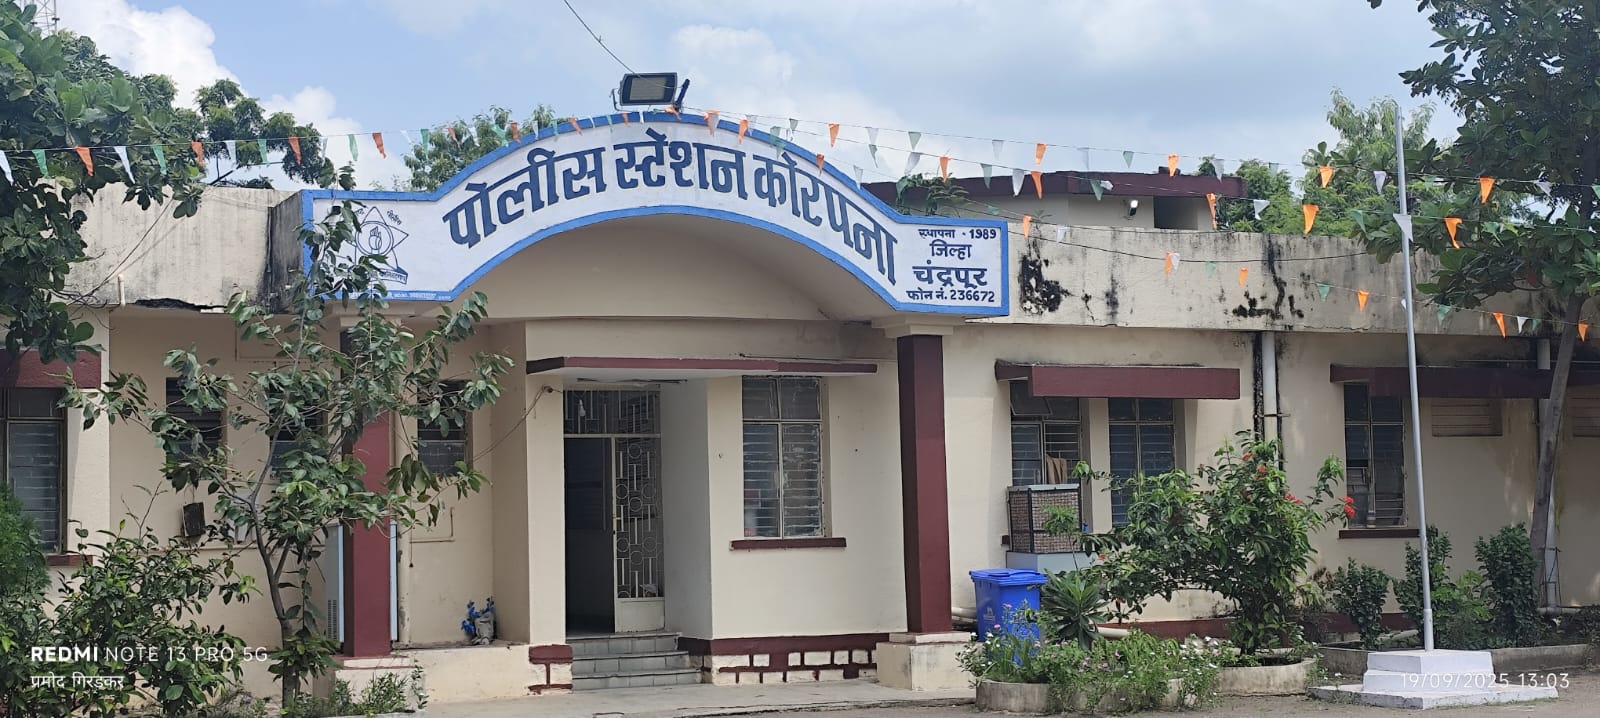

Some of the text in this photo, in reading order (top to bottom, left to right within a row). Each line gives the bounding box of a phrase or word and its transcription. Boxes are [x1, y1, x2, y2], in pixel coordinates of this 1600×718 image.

[442, 128, 899, 286] पोलीस स्टेशन कोरपना
[918, 228, 956, 239] स्थापना
[969, 228, 997, 240] 1989
[929, 238, 972, 260] जिल्हा
[912, 259, 988, 289] चंद्रपूर
[906, 286, 933, 301] फोन
[950, 289, 995, 303] 236672
